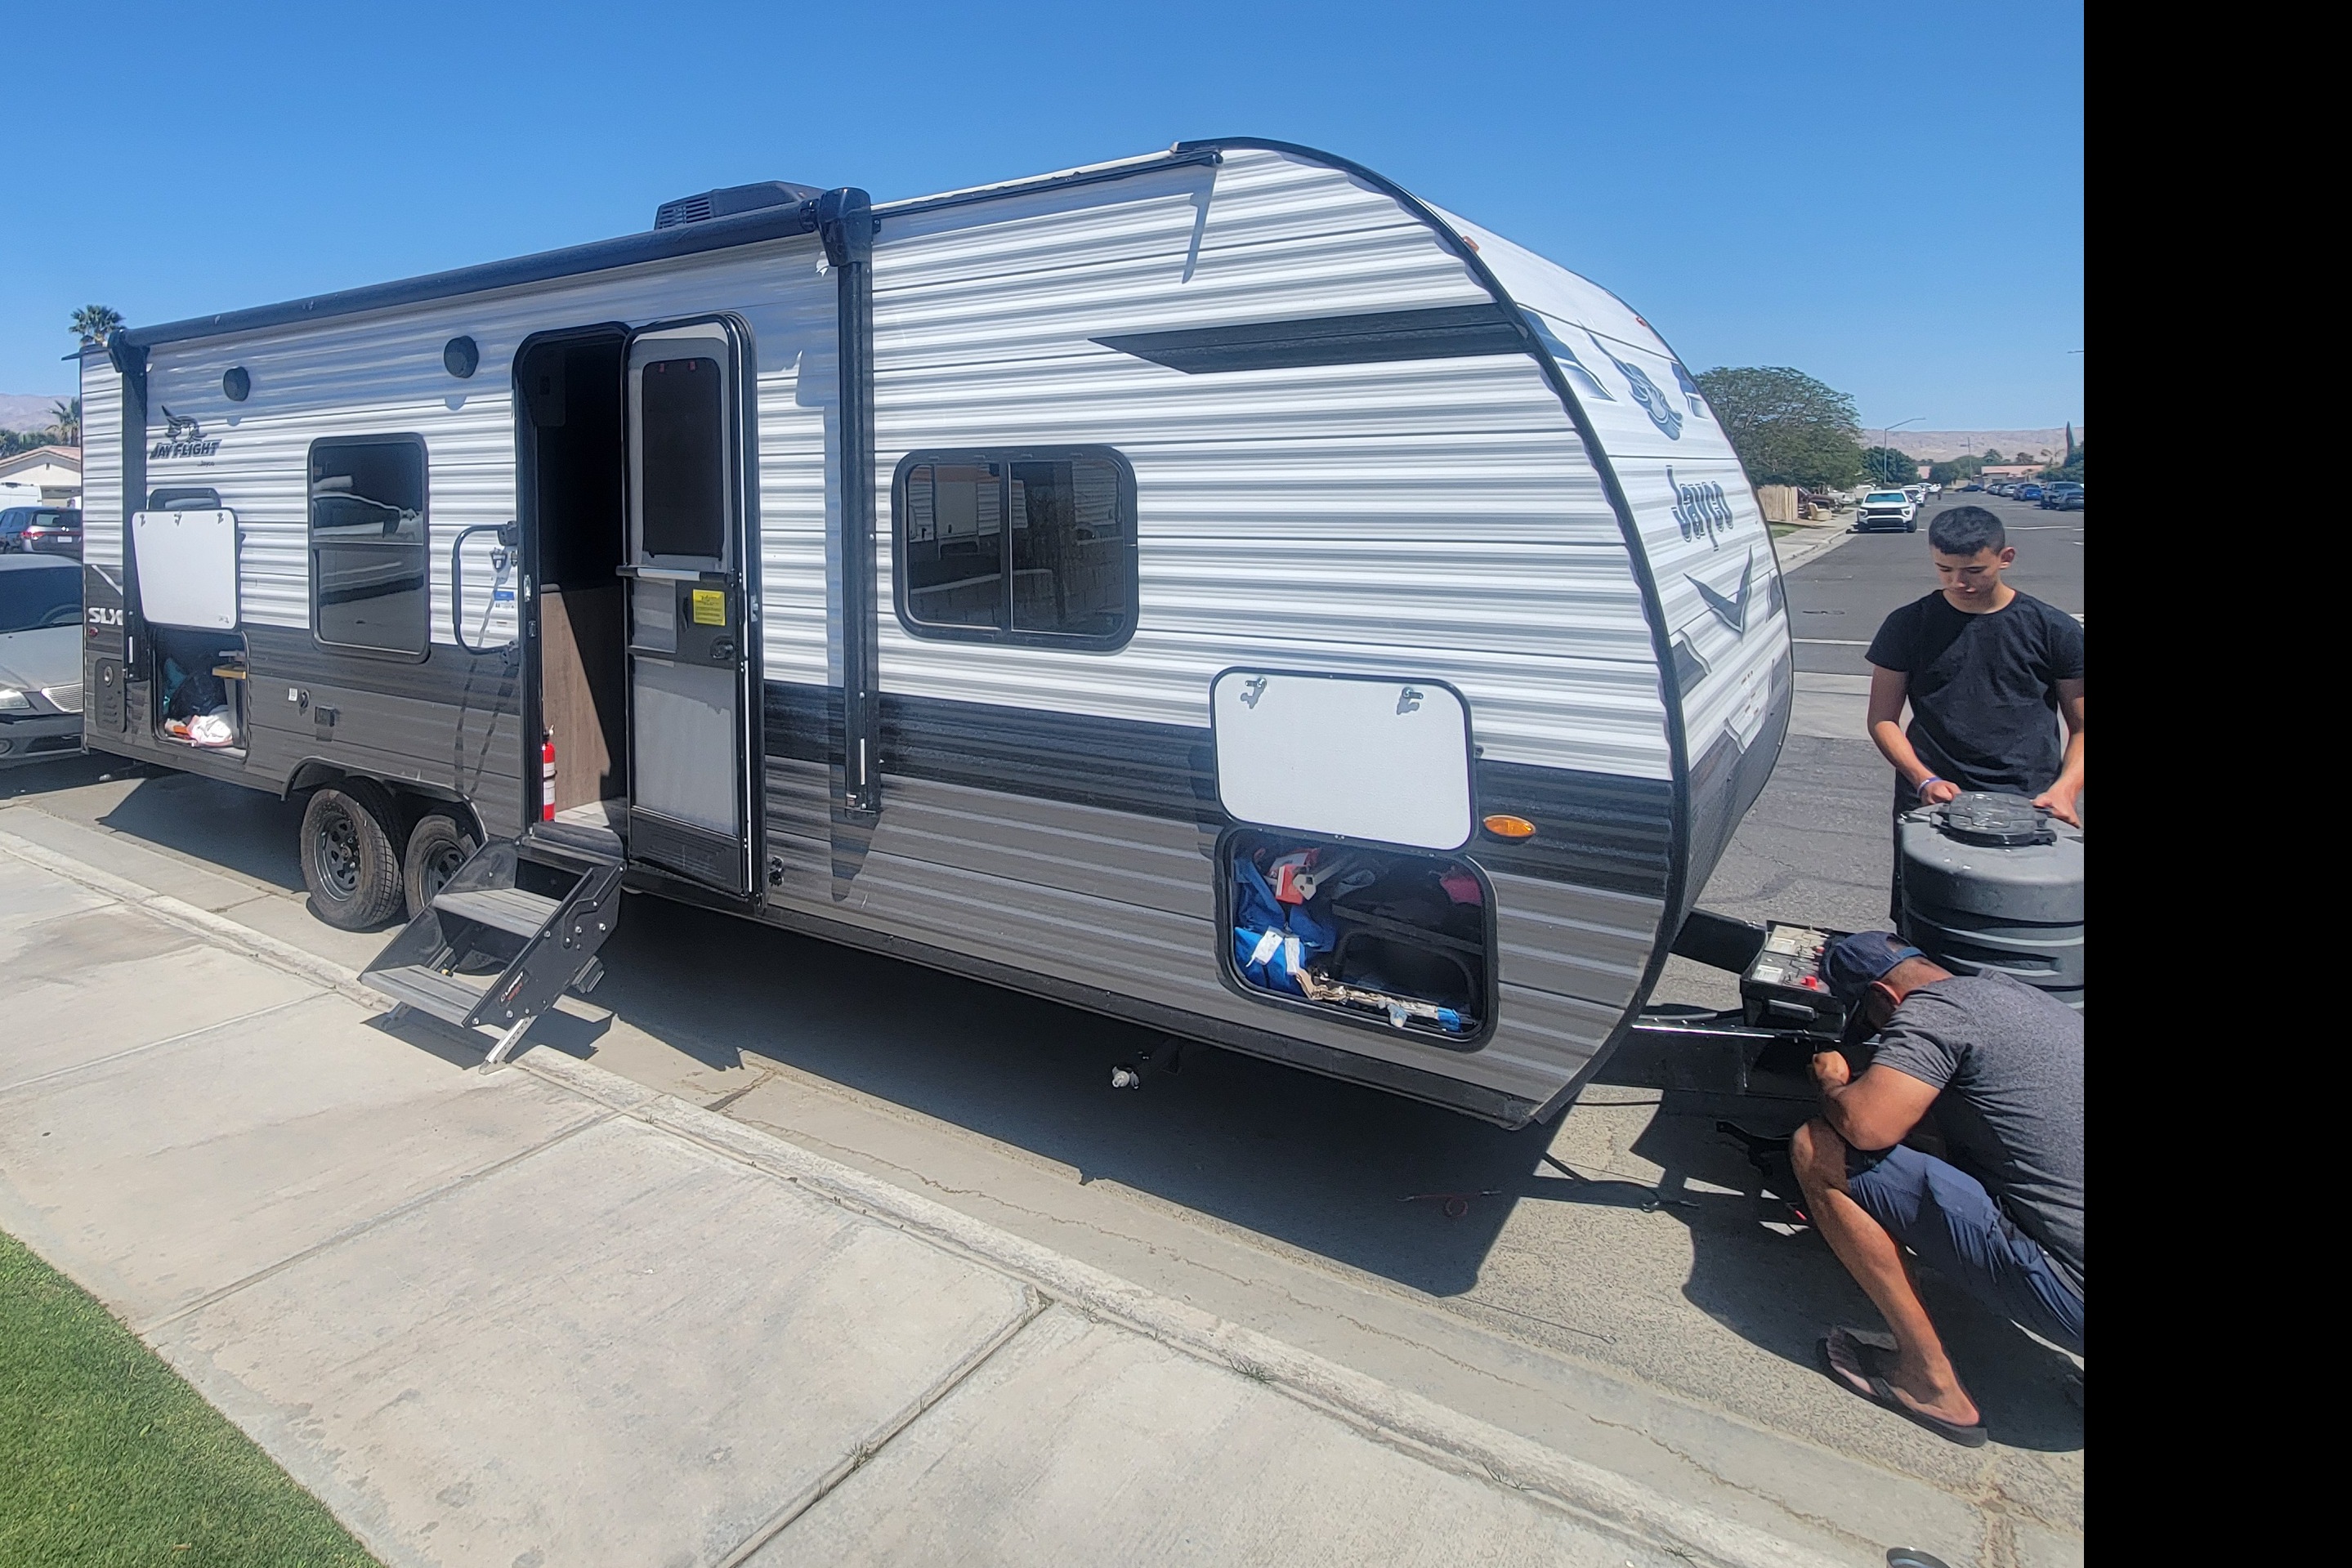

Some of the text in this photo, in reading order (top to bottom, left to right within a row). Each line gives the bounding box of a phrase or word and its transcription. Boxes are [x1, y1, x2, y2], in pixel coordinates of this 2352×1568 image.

[149, 439, 223, 460] JAY FLIGHT
[1666, 464, 1733, 552] Jayco
[87, 607, 123, 626] SLX
